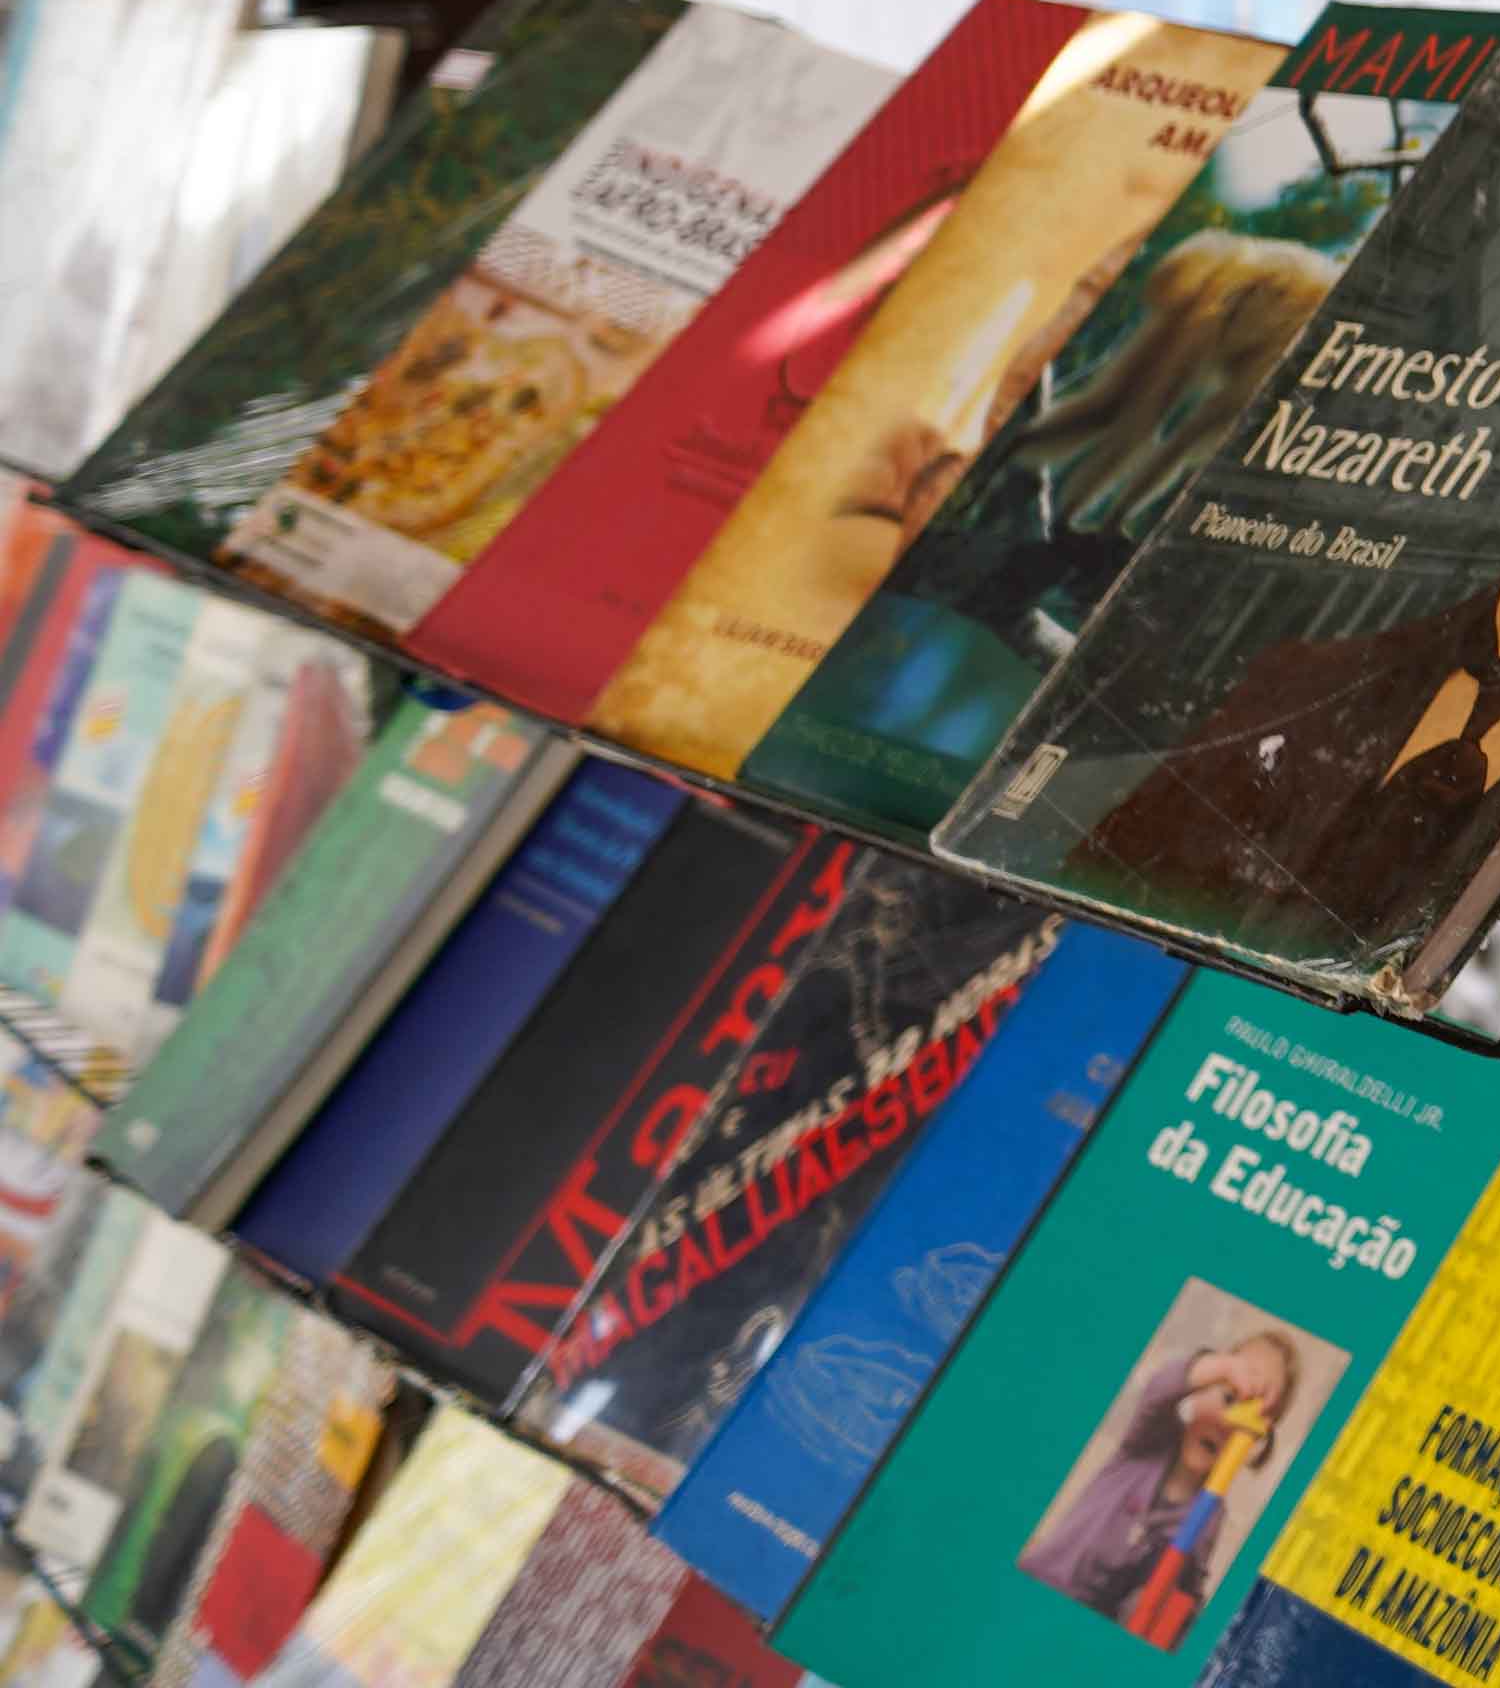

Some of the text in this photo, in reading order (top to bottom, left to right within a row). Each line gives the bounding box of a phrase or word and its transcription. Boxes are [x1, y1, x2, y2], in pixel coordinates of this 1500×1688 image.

[1290, 24, 1498, 101] MAMI
[1243, 399, 1493, 501] Nazareth
[1289, 520, 1325, 556] do
[1326, 526, 1406, 569] Brasil
[1185, 1051, 1373, 1179] Filosofia
[1147, 1119, 1418, 1281] da Educação
[1334, 1545, 1385, 1611] DA
